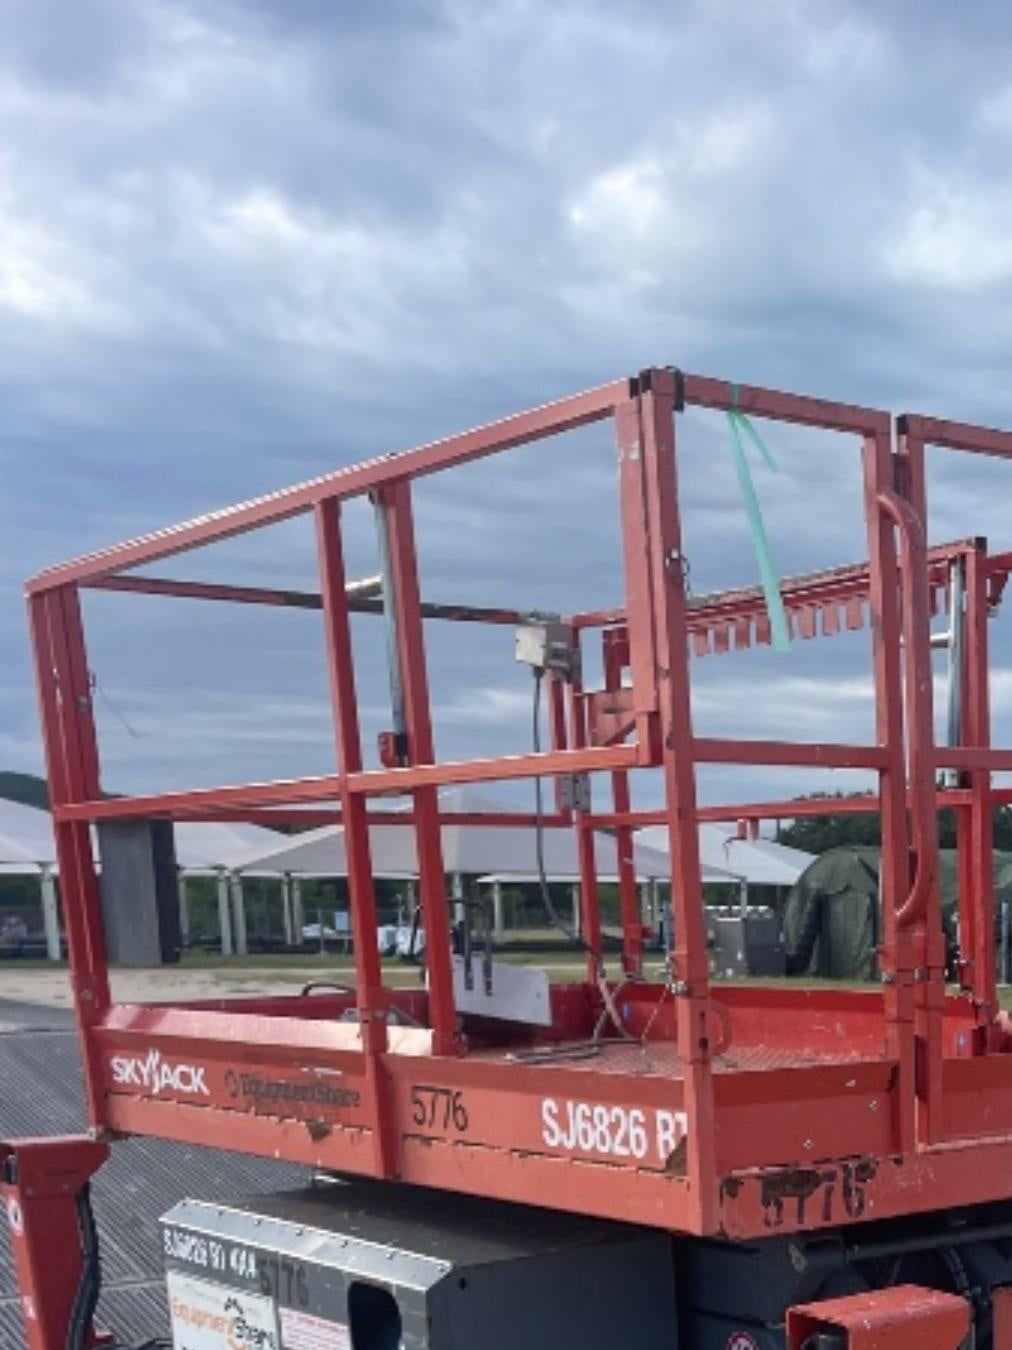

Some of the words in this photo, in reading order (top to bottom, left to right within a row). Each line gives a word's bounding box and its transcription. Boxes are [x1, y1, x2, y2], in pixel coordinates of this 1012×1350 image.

[110, 1049, 210, 1096] SKYJACK
[411, 1085, 468, 1131] 5776
[542, 1097, 648, 1159] SJ6826
